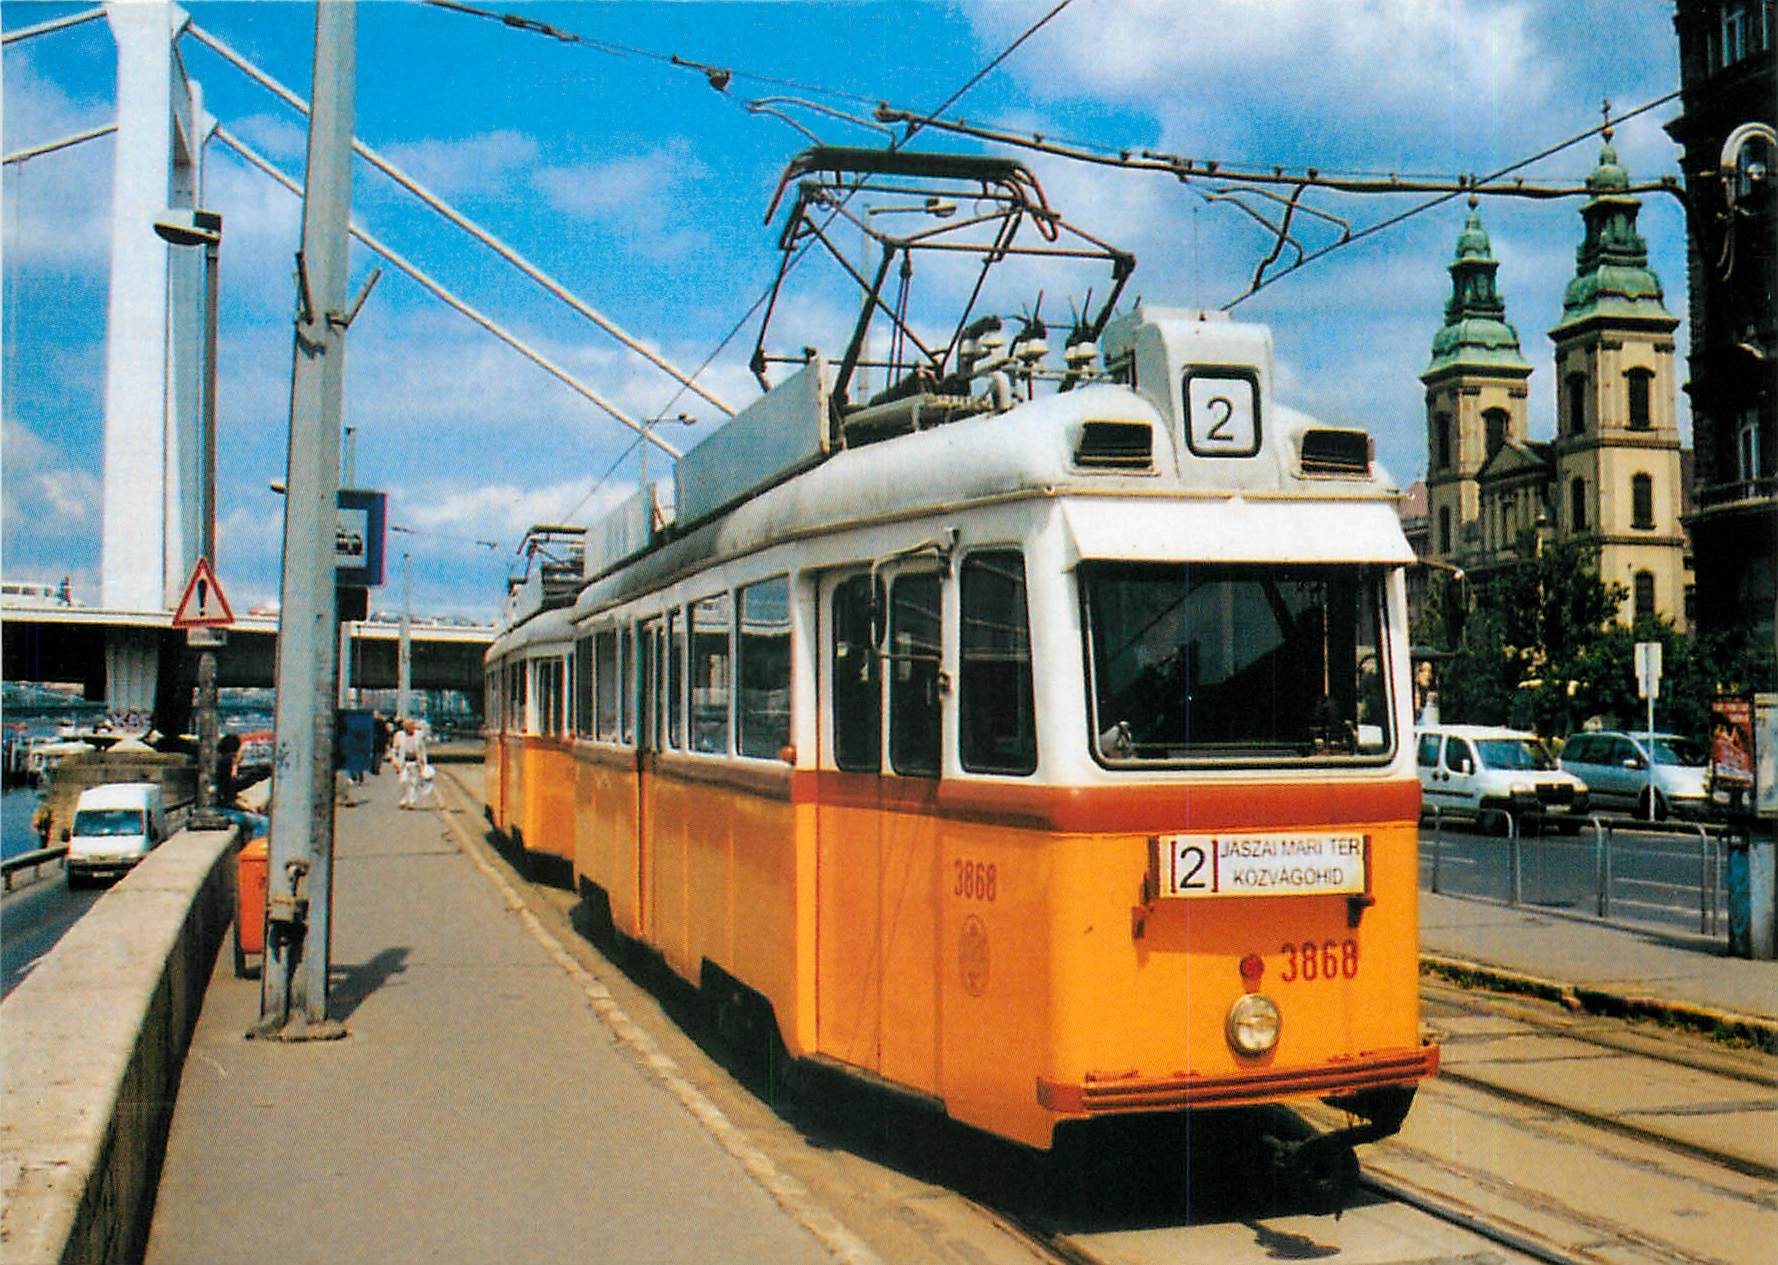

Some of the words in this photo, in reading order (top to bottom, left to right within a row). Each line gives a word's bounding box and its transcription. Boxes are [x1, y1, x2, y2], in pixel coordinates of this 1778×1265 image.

[1206, 396, 1233, 441] 2
[954, 858, 997, 902] 3868
[1179, 846, 1206, 889] 2
[1281, 938, 1359, 982] 3868
